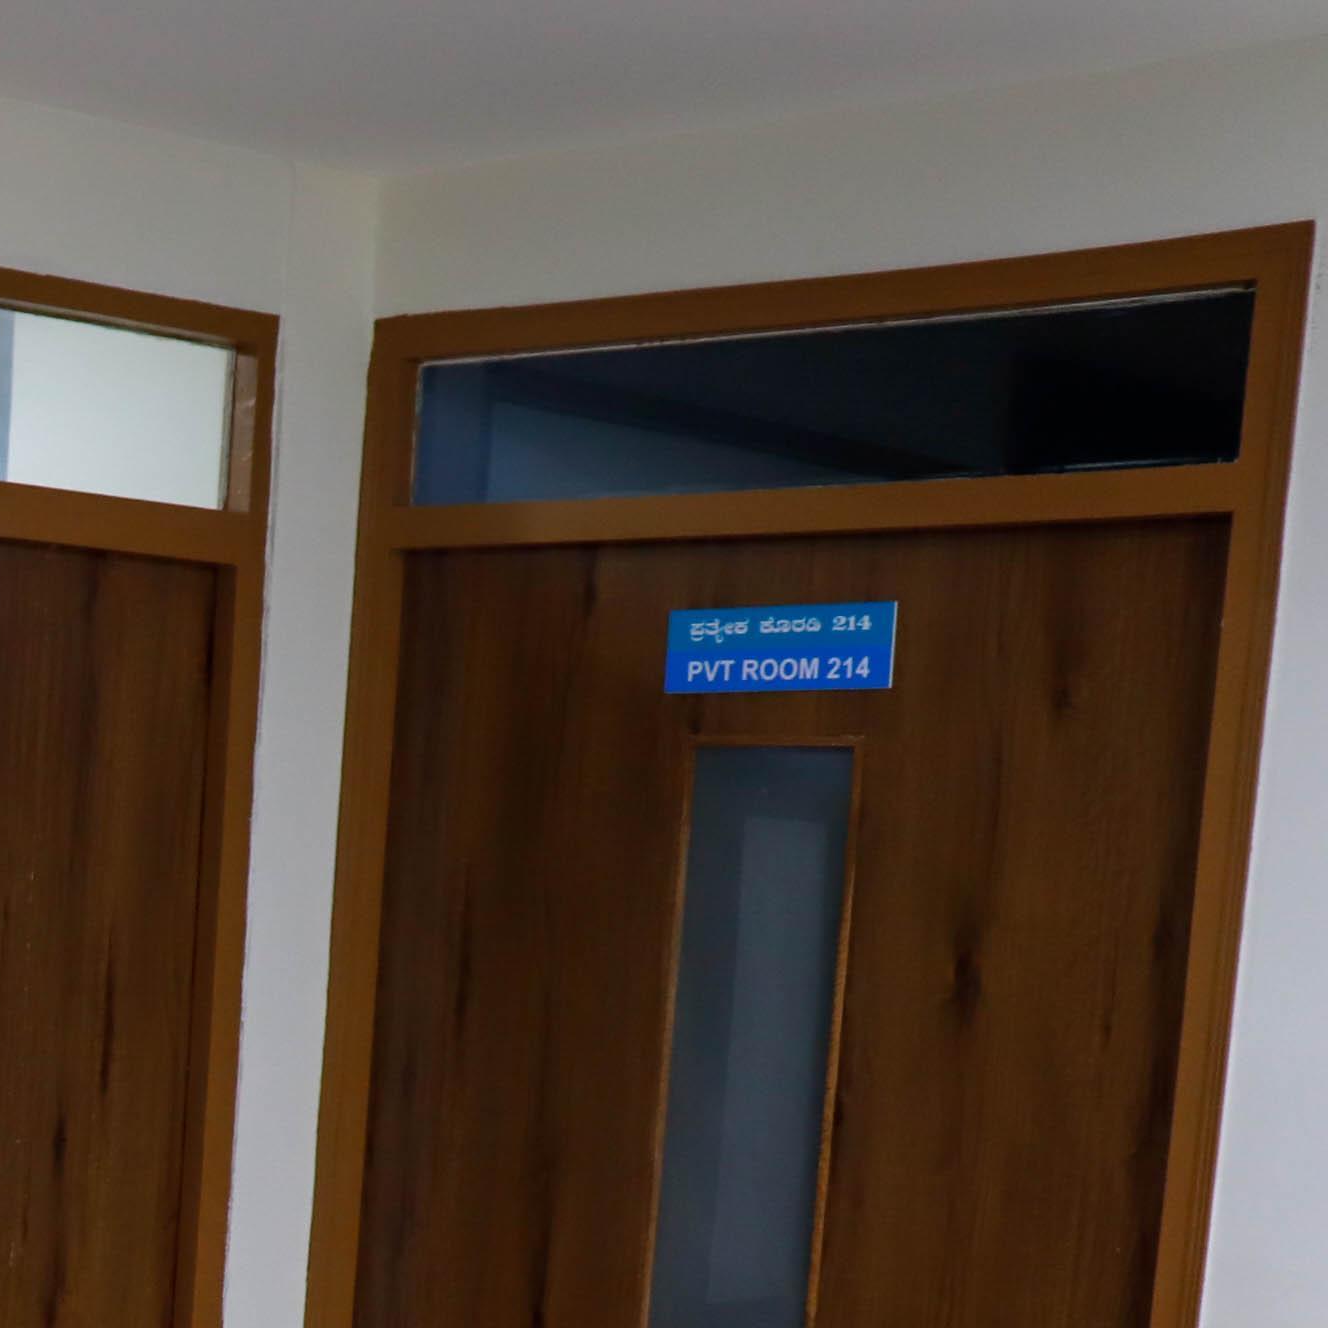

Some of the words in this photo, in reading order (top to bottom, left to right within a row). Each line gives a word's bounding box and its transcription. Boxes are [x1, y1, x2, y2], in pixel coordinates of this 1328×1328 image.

[832, 615, 873, 632] 214
[687, 660, 735, 683] PVT
[741, 657, 820, 682] ROOM
[826, 655, 871, 680] 214
